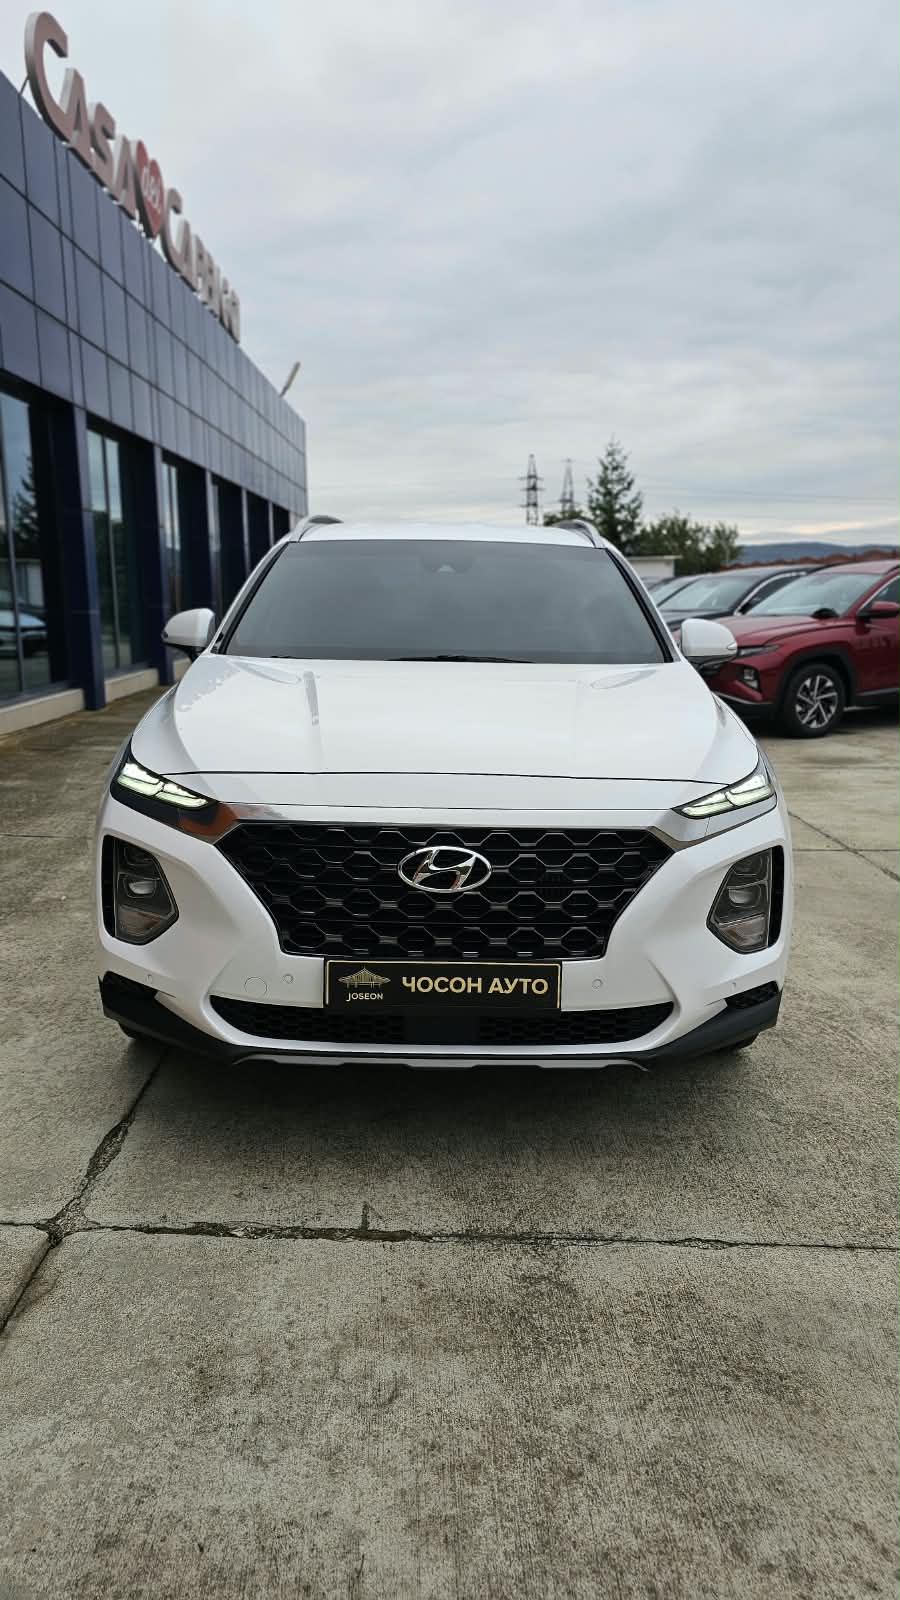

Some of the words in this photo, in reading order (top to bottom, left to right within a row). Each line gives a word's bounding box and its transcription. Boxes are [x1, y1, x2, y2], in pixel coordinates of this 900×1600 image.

[24, 11, 138, 222] CASA
[402, 976, 482, 993] ЧОСОН
[487, 977, 549, 995] АУТО
[345, 992, 384, 1002] JOSEON
